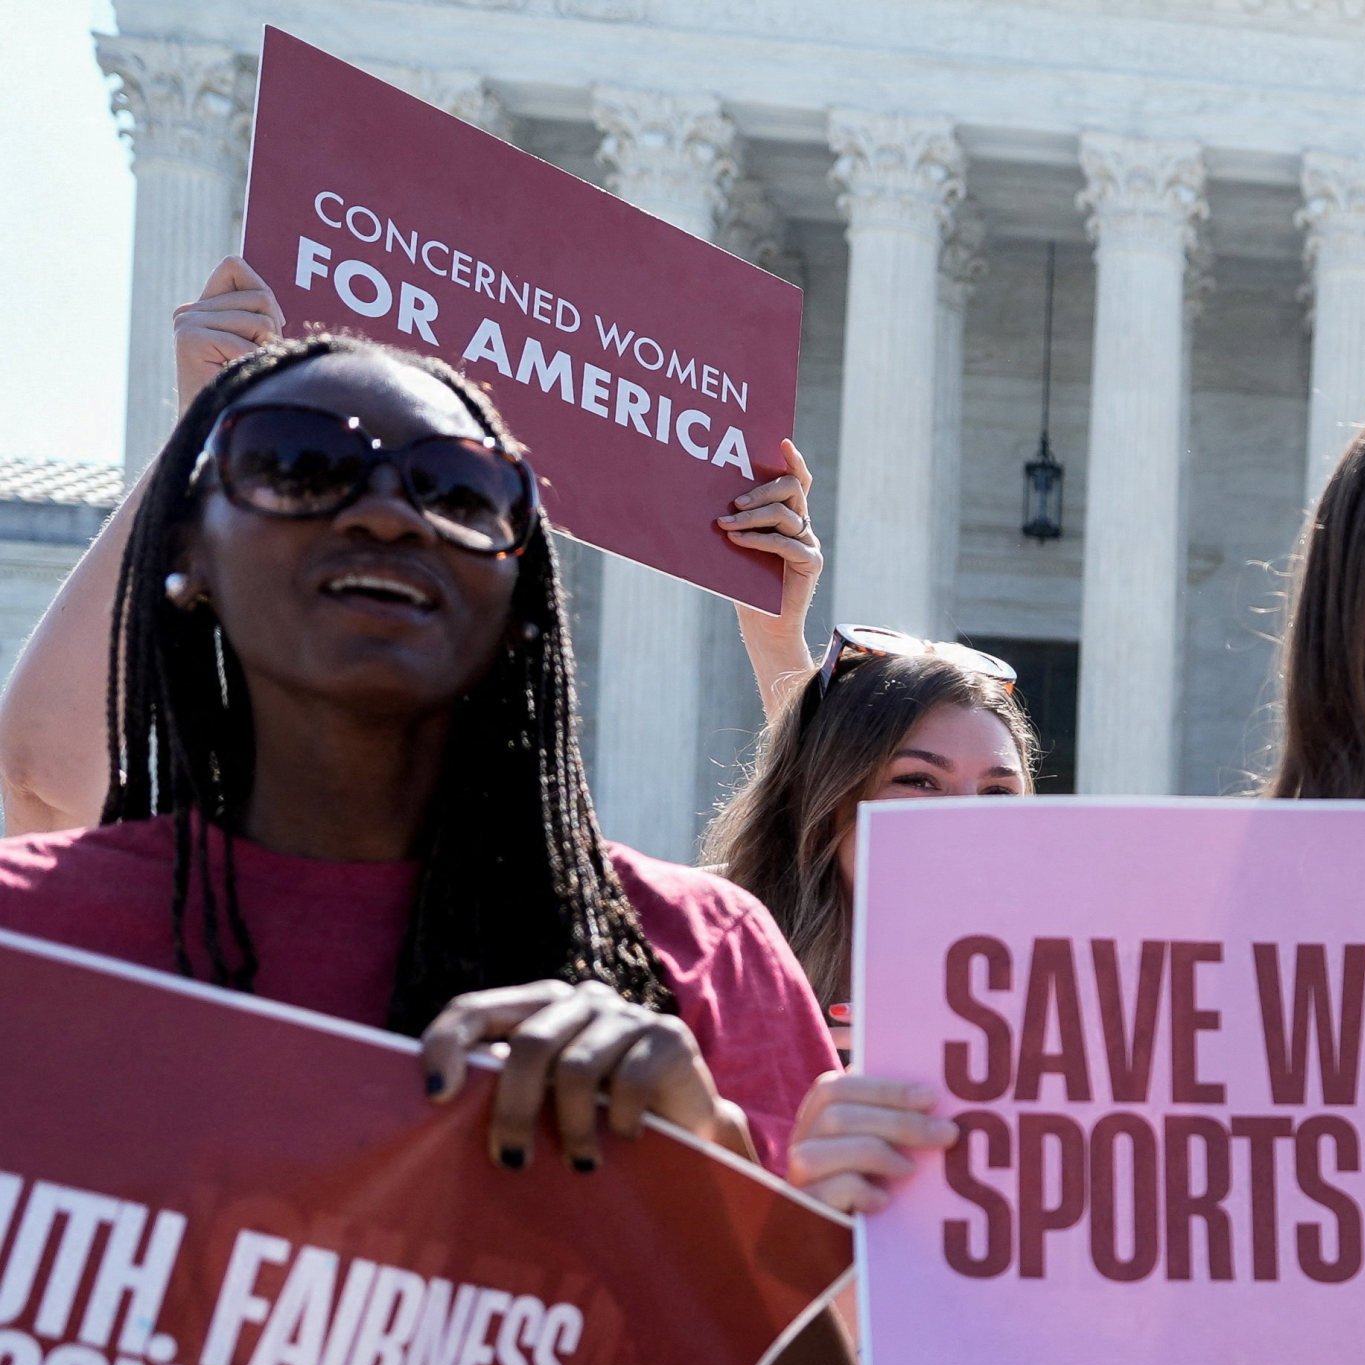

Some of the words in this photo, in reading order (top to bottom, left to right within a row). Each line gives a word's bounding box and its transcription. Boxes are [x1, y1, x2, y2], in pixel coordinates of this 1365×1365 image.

[295, 235, 440, 347] FOR
[462, 318, 754, 481] AMERICA
[314, 191, 581, 333] CONCERNED
[595, 315, 748, 413] WOMEN
[944, 934, 1226, 1105] SAVE
[943, 1110, 1363, 1283] SPORTS
